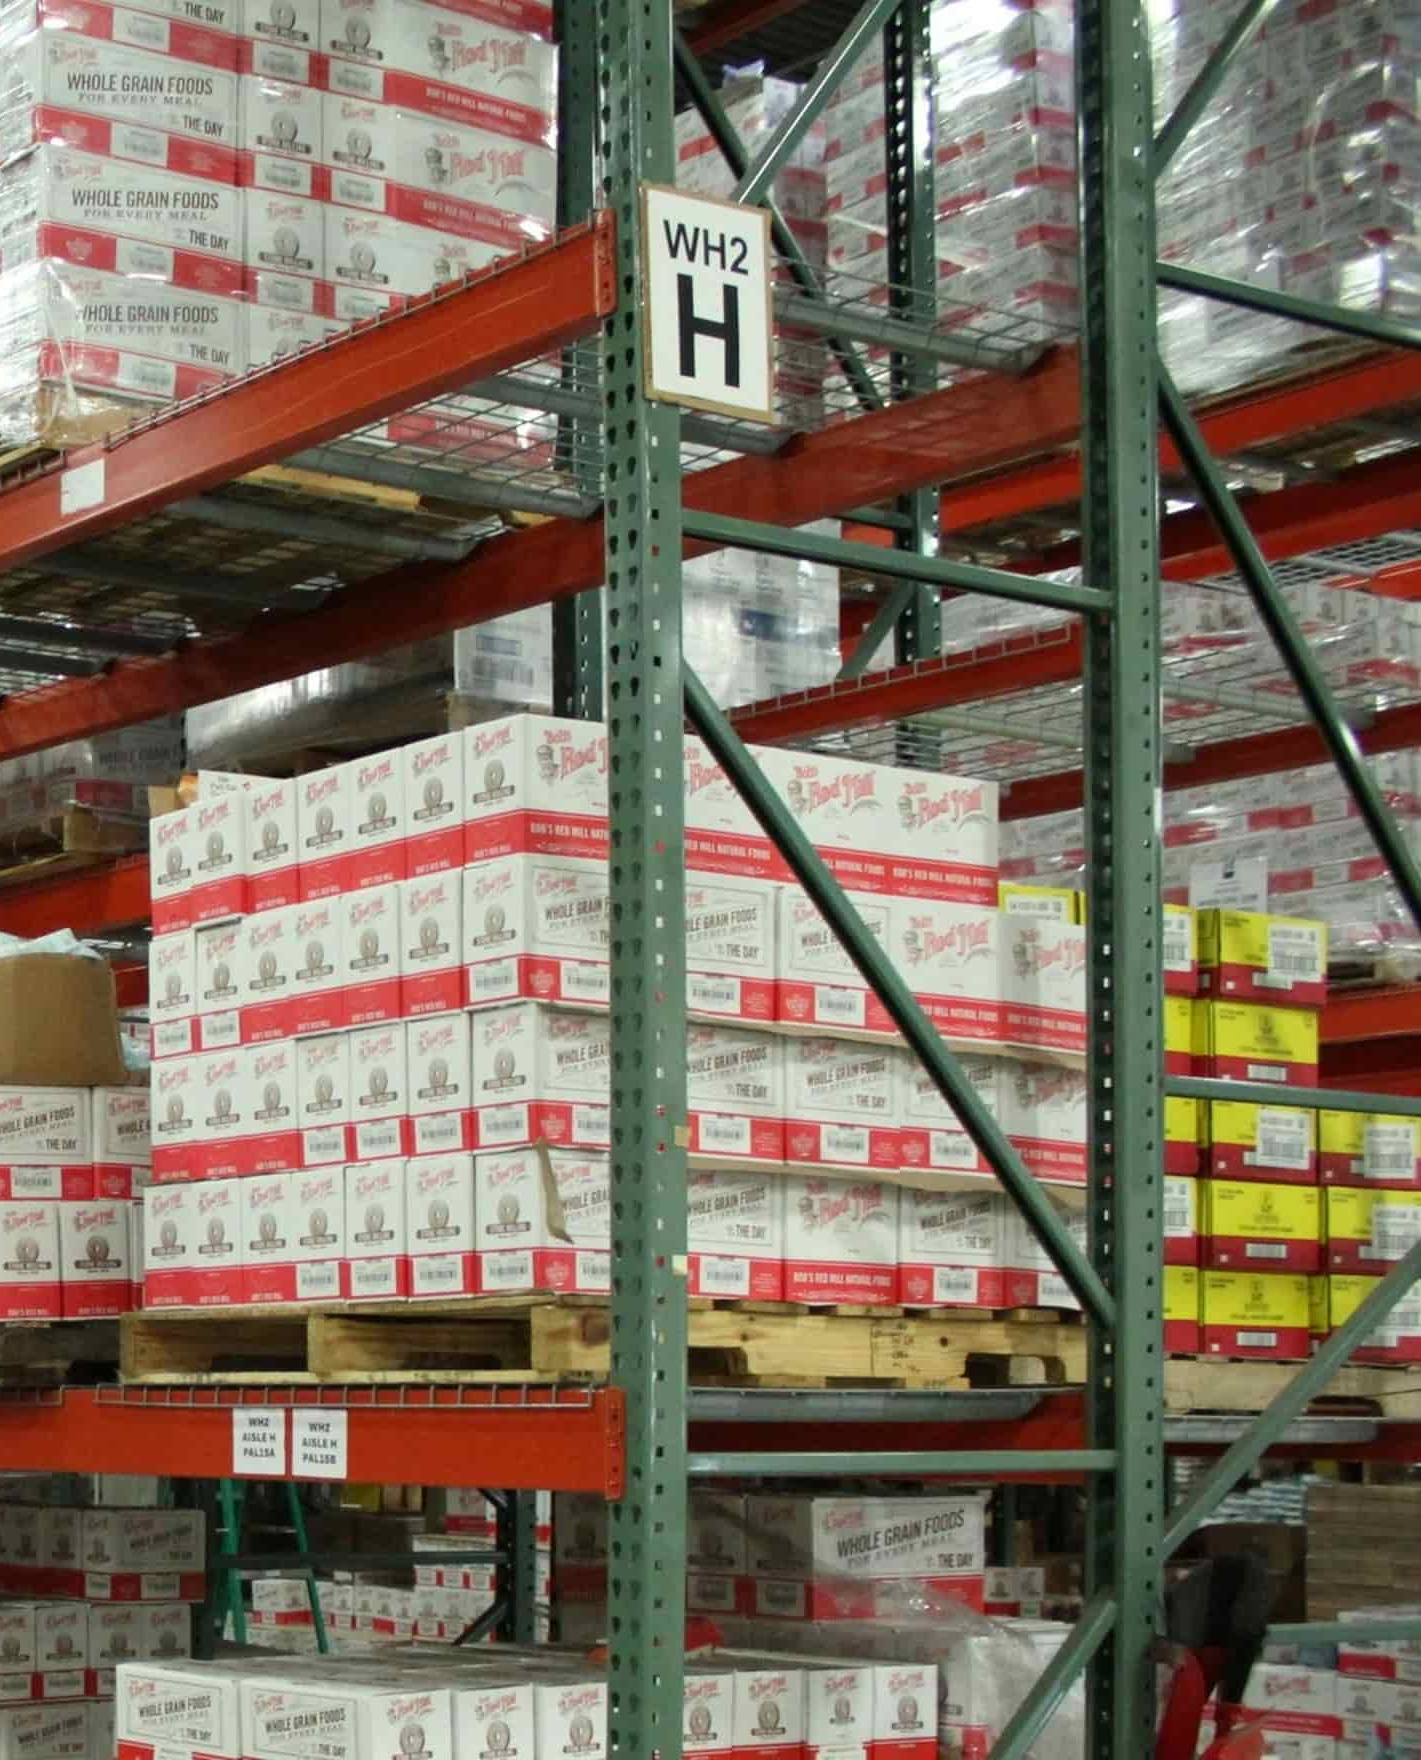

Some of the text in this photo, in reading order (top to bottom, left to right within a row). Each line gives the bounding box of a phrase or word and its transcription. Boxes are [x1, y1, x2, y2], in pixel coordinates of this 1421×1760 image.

[184, 3, 225, 25] THE DAY
[67, 72, 214, 96] WHOLE GRAIN FOODS
[184, 115, 223, 137] THE DAY
[72, 188, 219, 210] WHOLE GRAIN FOODS
[189, 229, 230, 250] THE DAY
[663, 219, 749, 275] WH2
[127, 305, 169, 323] GRAIN
[172, 306, 219, 324] FOODS
[676, 273, 741, 388] H
[190, 344, 230, 365] THE DAY
[546, 899, 602, 920] WHOLE GRAIN
[703, 907, 757, 929] GRAIN FOODS
[727, 944, 759, 960] THE DAY
[556, 1046, 585, 1065] WHOLE
[714, 1046, 767, 1069] GRAIN FOODS
[806, 1058, 885, 1088] WHOLE GRAIN FOODS
[736, 1083, 768, 1098] THE DAY
[855, 1093, 886, 1107] THE DAY
[49, 1105, 75, 1121] FOODS
[46, 1138, 60, 1150] THE
[714, 1186, 765, 1211] GRAIN FOODS
[736, 1224, 750, 1238] THE
[248, 1417, 269, 1427] WH2
[308, 1423, 331, 1433] WH2
[242, 1431, 276, 1442] AISLE H
[302, 1438, 337, 1448] AISLE H
[837, 1508, 965, 1558] WHOLE GRAIN FOODS
[937, 1553, 974, 1568] THE DAY
[138, 1695, 211, 1717] WHOLE GRAIN FOODS
[265, 1708, 346, 1733] WHOLE GRAIN FOODS
